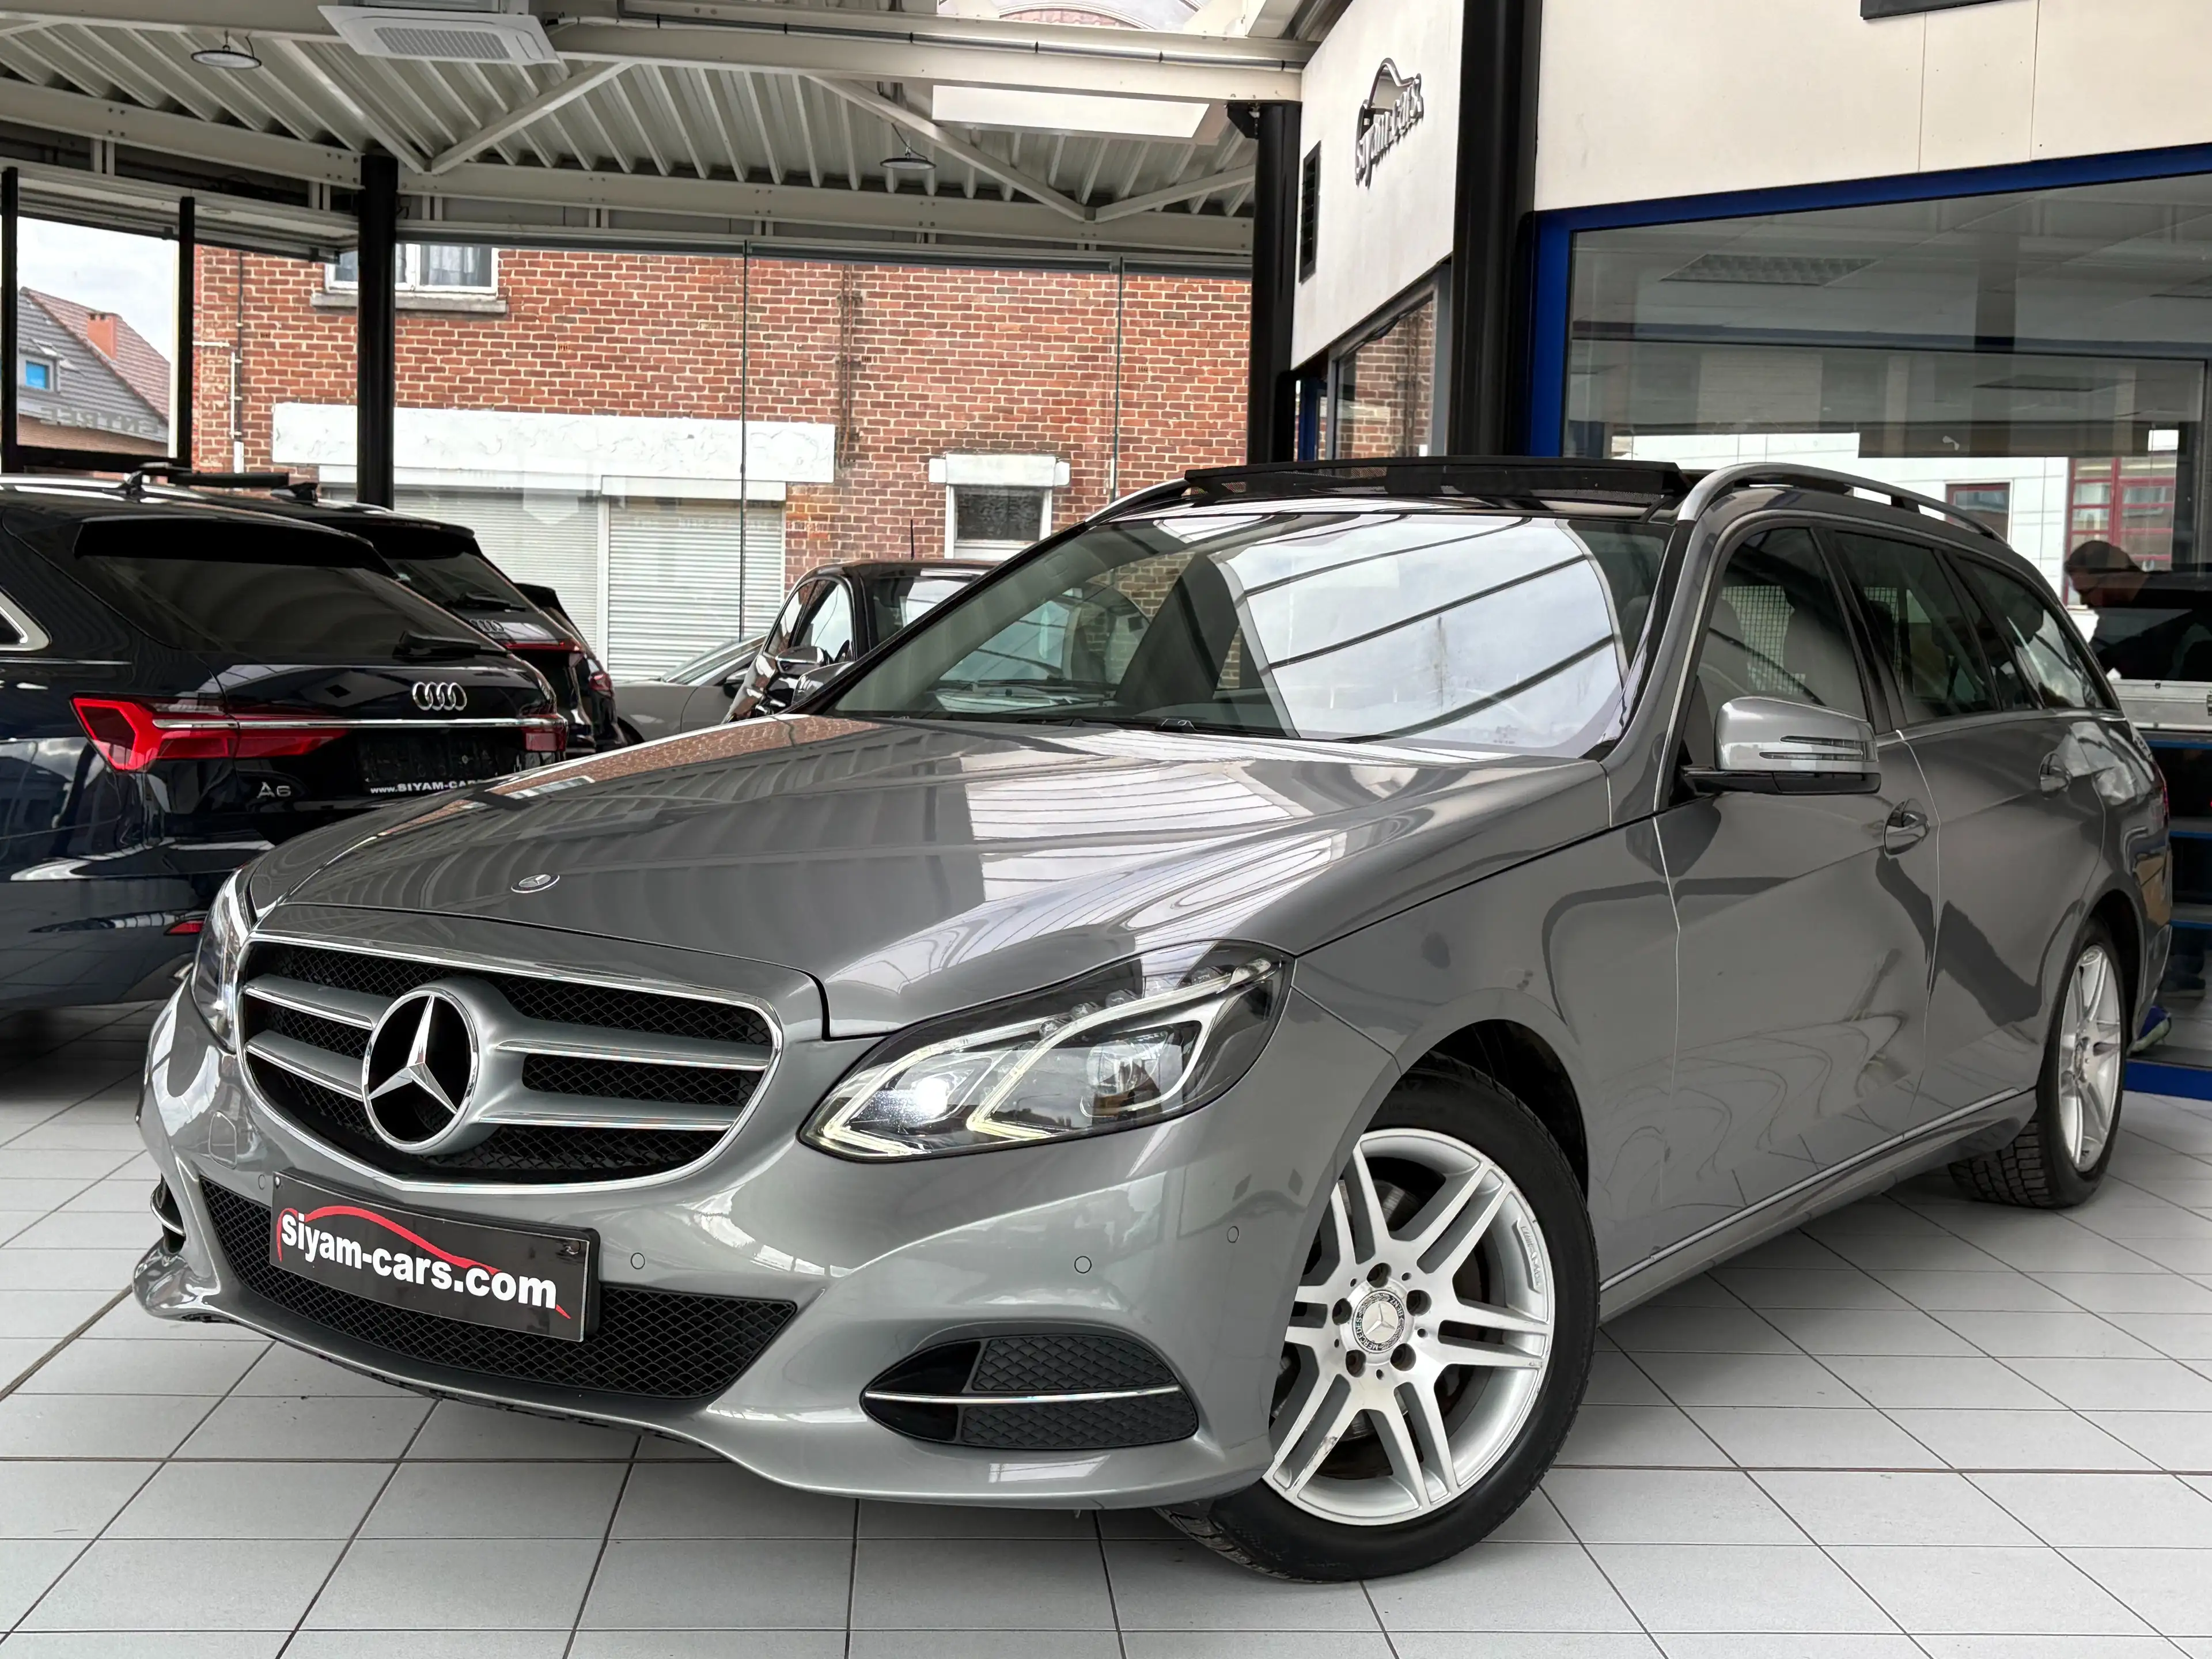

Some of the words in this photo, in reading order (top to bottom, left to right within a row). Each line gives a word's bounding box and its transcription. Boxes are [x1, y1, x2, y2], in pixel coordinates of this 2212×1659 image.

[256, 781, 291, 799] A6
[281, 1212, 557, 1309] Siyam-cars.com
[1355, 1317, 1379, 1350] MERCEDES
